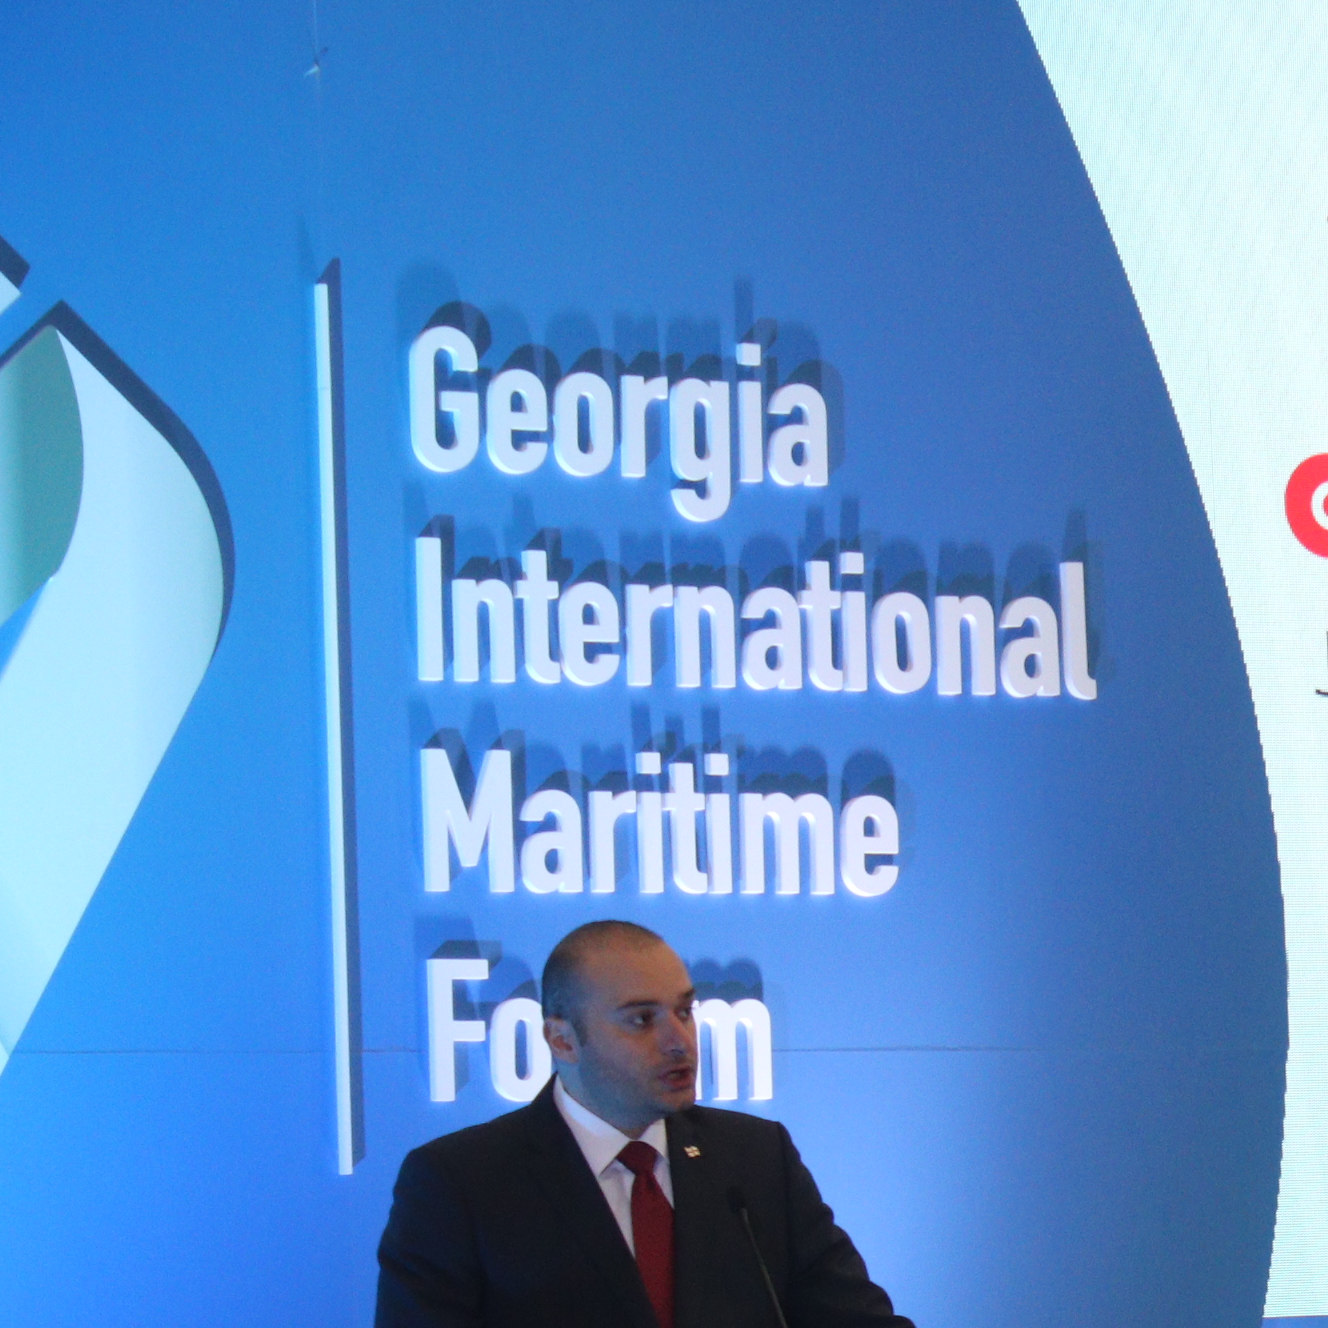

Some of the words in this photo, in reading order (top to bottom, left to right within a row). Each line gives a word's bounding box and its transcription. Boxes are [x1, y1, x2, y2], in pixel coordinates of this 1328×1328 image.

[409, 325, 829, 522] Georgia
[415, 537, 1098, 701] International
[420, 747, 900, 897] Maritime
[426, 958, 773, 1103] Fom
